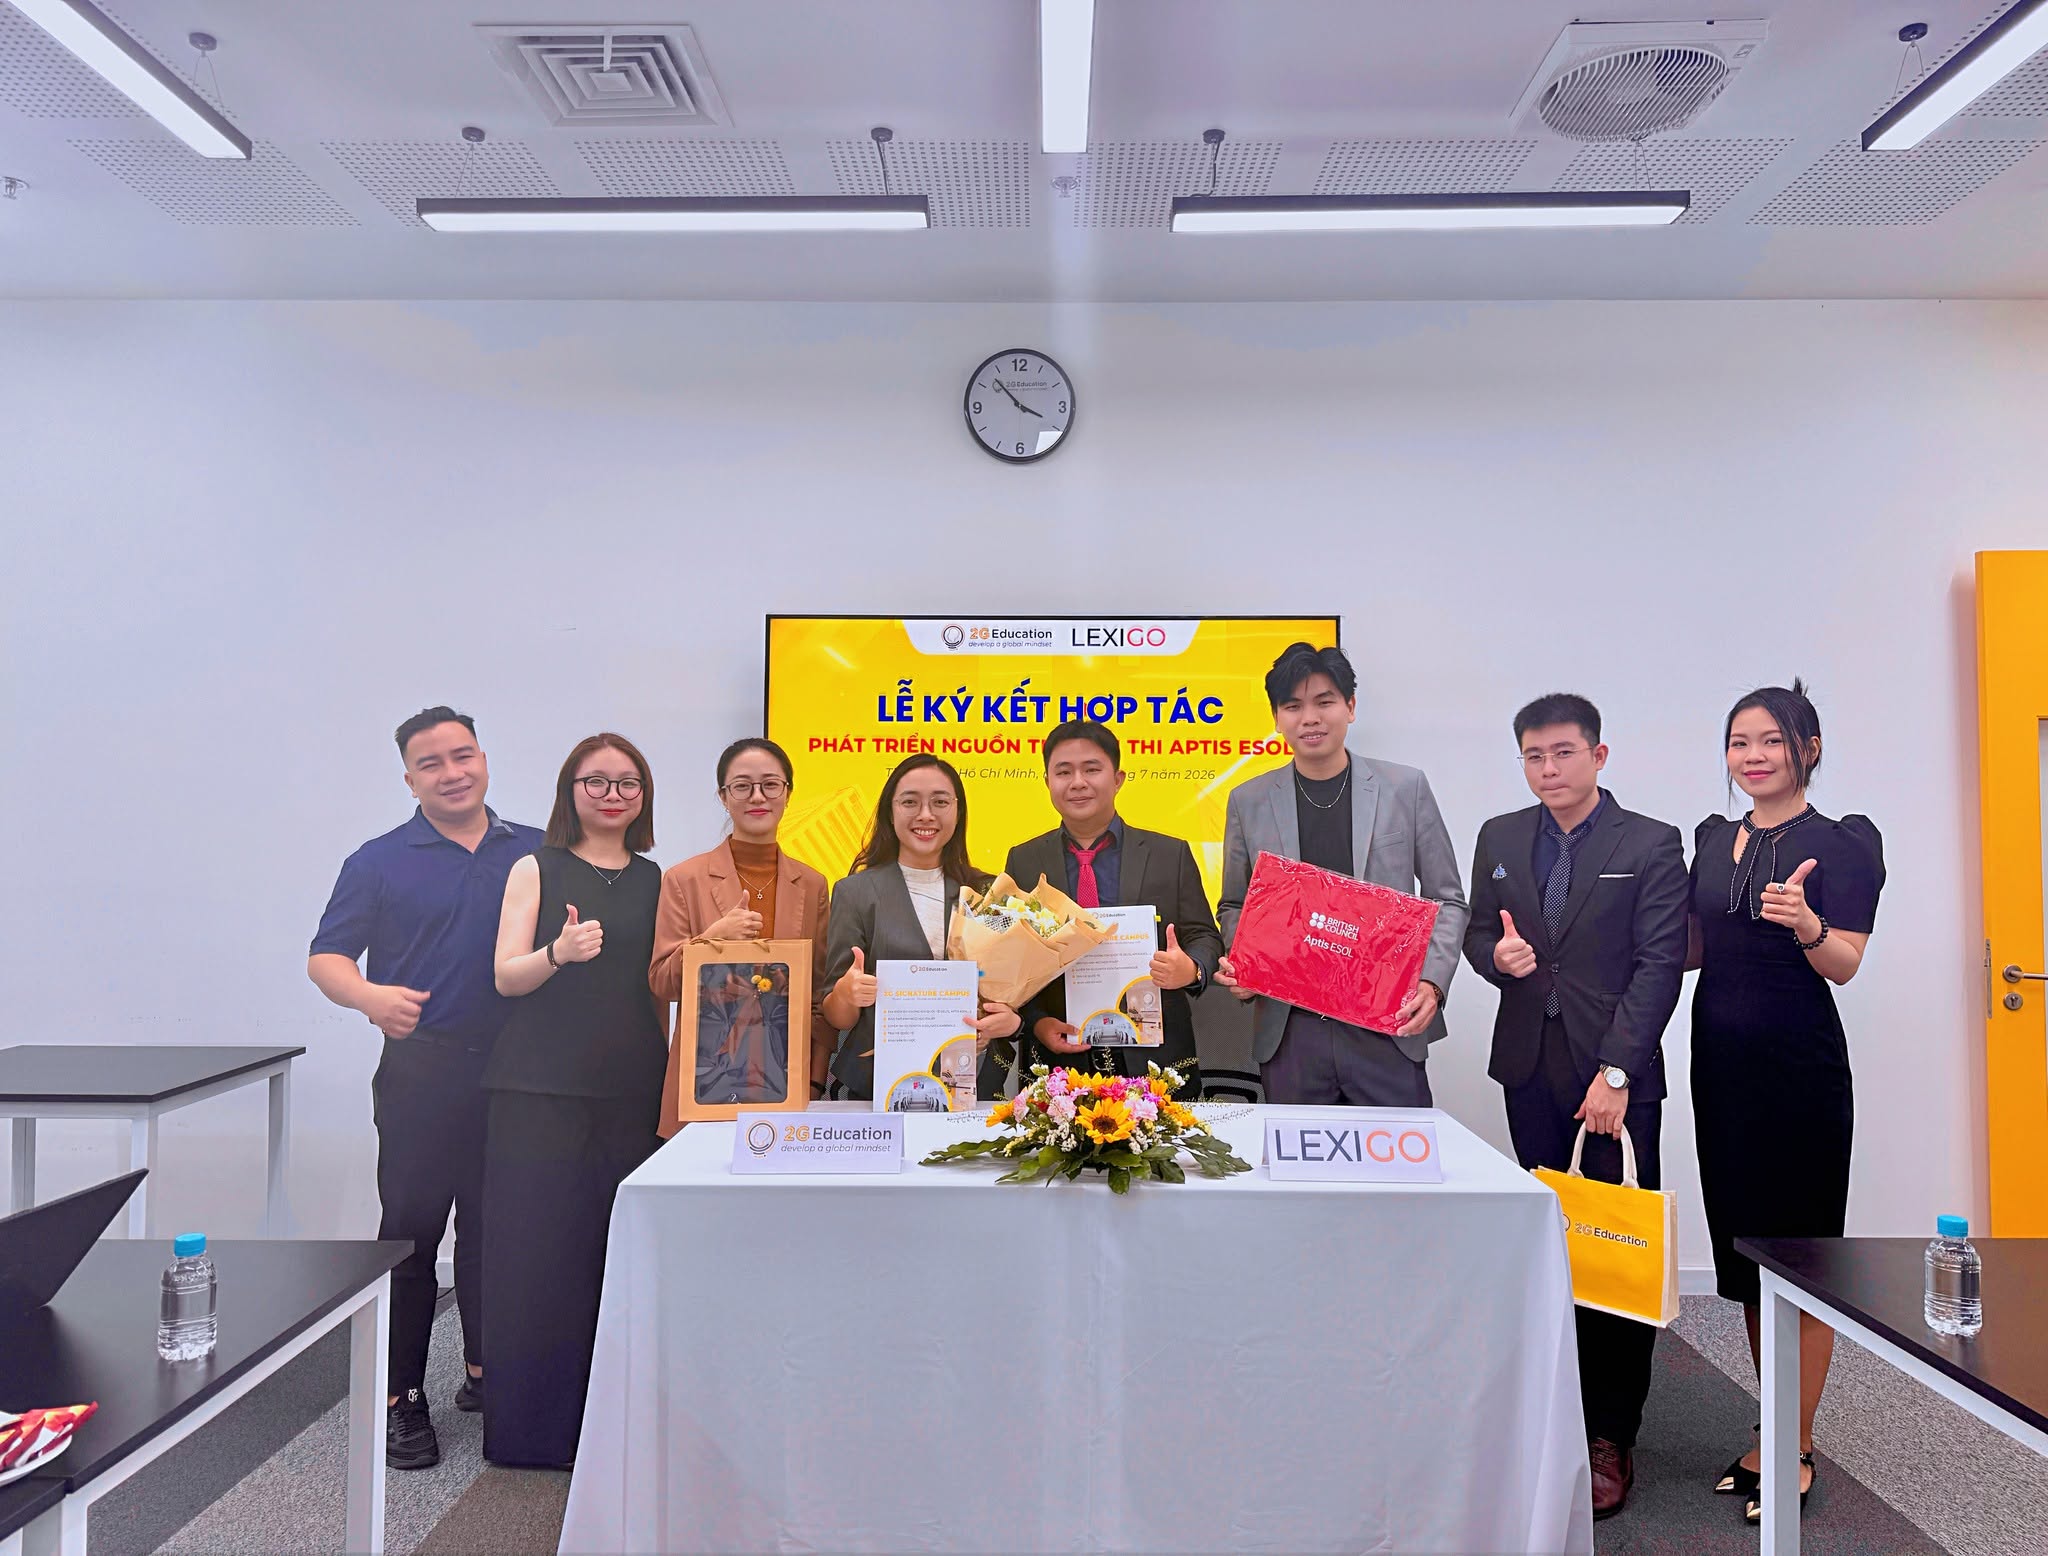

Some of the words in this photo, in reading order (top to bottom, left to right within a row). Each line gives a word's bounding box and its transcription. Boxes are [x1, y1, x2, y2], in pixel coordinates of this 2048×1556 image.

[1011, 358, 1028, 372] 12
[972, 401, 982, 414] 9
[1058, 400, 1067, 414] 3
[1015, 442, 1025, 455] 6
[969, 627, 990, 640] 2G
[991, 628, 1053, 639] Education
[1071, 628, 1166, 647] LEXIGO
[1002, 641, 1023, 649] global
[878, 678, 914, 722] LỄ
[923, 685, 974, 722] KÝ
[983, 677, 1051, 723] KẾT
[1146, 686, 1224, 724] TÁC
[808, 734, 866, 753] PHÁT
[872, 732, 935, 754] TRIỂN
[942, 733, 1021, 754] NGUỒN
[1127, 740, 1162, 755] THI
[1169, 740, 1232, 755] APTIS
[1239, 740, 1294, 756] ESOL
[980, 767, 1002, 779] Chí
[1004, 767, 1039, 780] Minh,
[1139, 769, 1148, 780] 7
[1150, 769, 1181, 780] năm
[1184, 769, 1216, 780] 2026
[1325, 924, 1359, 941] COUNCIL
[1327, 917, 1360, 934] BRITISH
[1304, 934, 1330, 950] Aptis
[1330, 942, 1354, 958] ESOL
[783, 1125, 810, 1142] 2G
[813, 1126, 892, 1140] Education
[781, 1144, 816, 1153] develop
[825, 1144, 854, 1154] global
[855, 1144, 891, 1152] mindset
[1274, 1129, 1431, 1163] LEXIGO
[1574, 1222, 1593, 1236] 2G
[1594, 1227, 1648, 1248] Education
